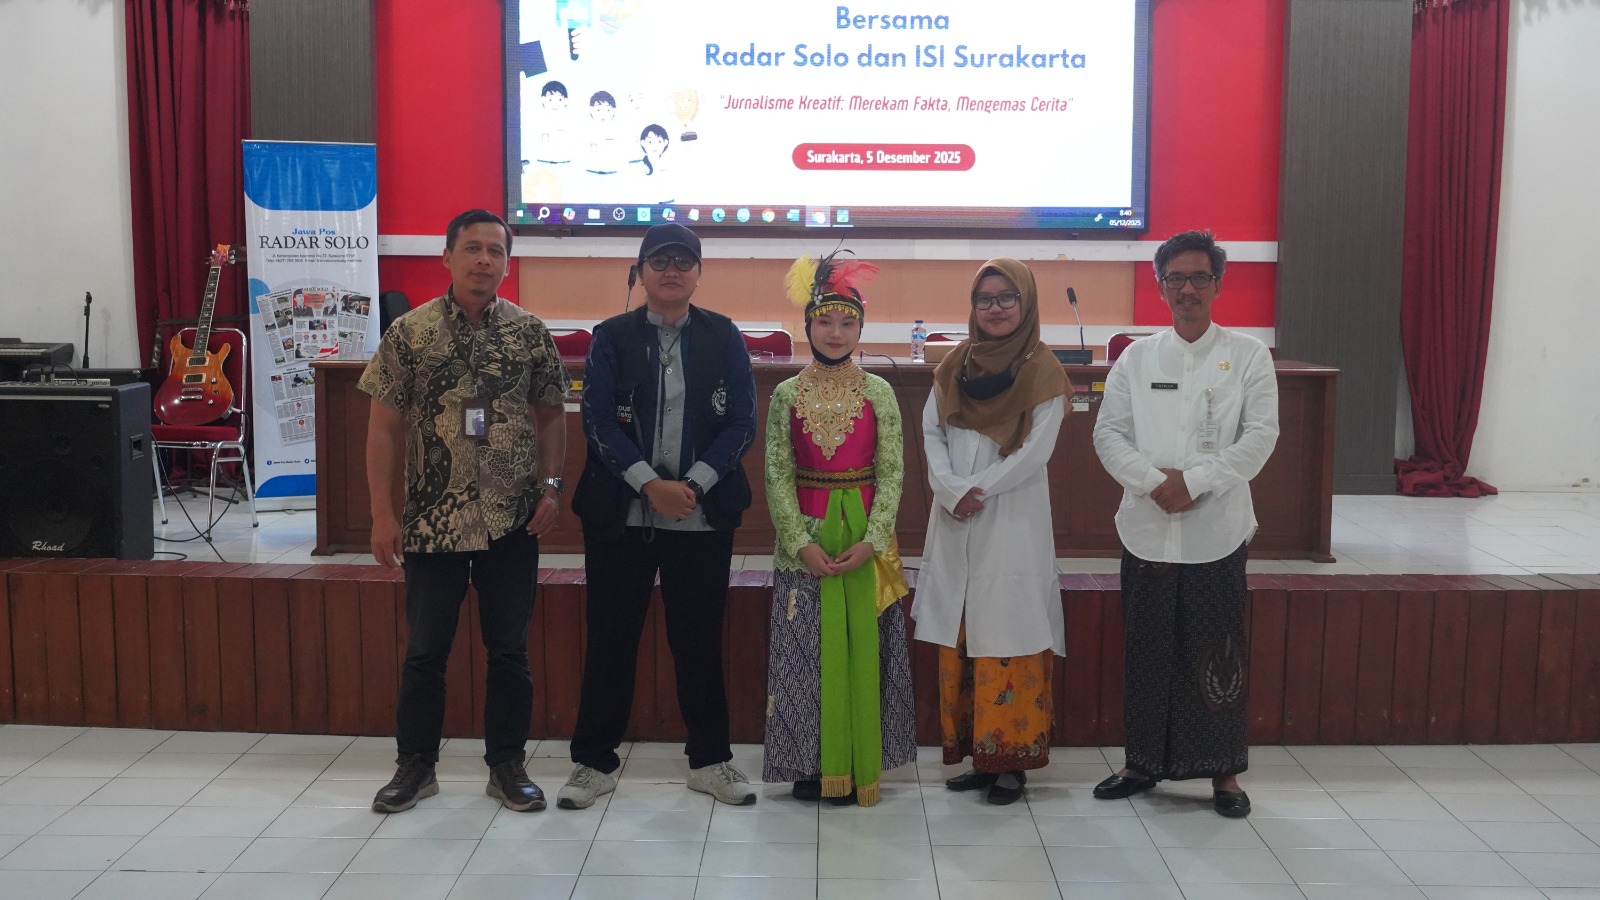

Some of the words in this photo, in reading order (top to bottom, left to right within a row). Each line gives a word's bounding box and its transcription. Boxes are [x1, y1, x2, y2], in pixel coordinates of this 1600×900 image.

[836, 6, 949, 30] Bersama
[704, 43, 786, 69] Radar
[793, 43, 849, 69] Solo
[857, 43, 907, 69] dan
[915, 44, 946, 69] ISI
[953, 44, 1087, 70] Surakarta
[799, 95, 845, 111] Kreatif:
[849, 95, 909, 112] Merekam
[912, 96, 950, 113] Fakta,
[956, 96, 1027, 115] Mengemas
[806, 149, 864, 167] Surakarta,
[866, 150, 875, 165] 5
[876, 149, 930, 165] Desember
[933, 149, 962, 165] 2025
[1119, 209, 1132, 217] 8:40
[1109, 219, 1142, 227] 05/12/2025
[259, 235, 321, 249] RADAR
[324, 235, 369, 249] SOLO
[31, 540, 65, 552] Rhoad
